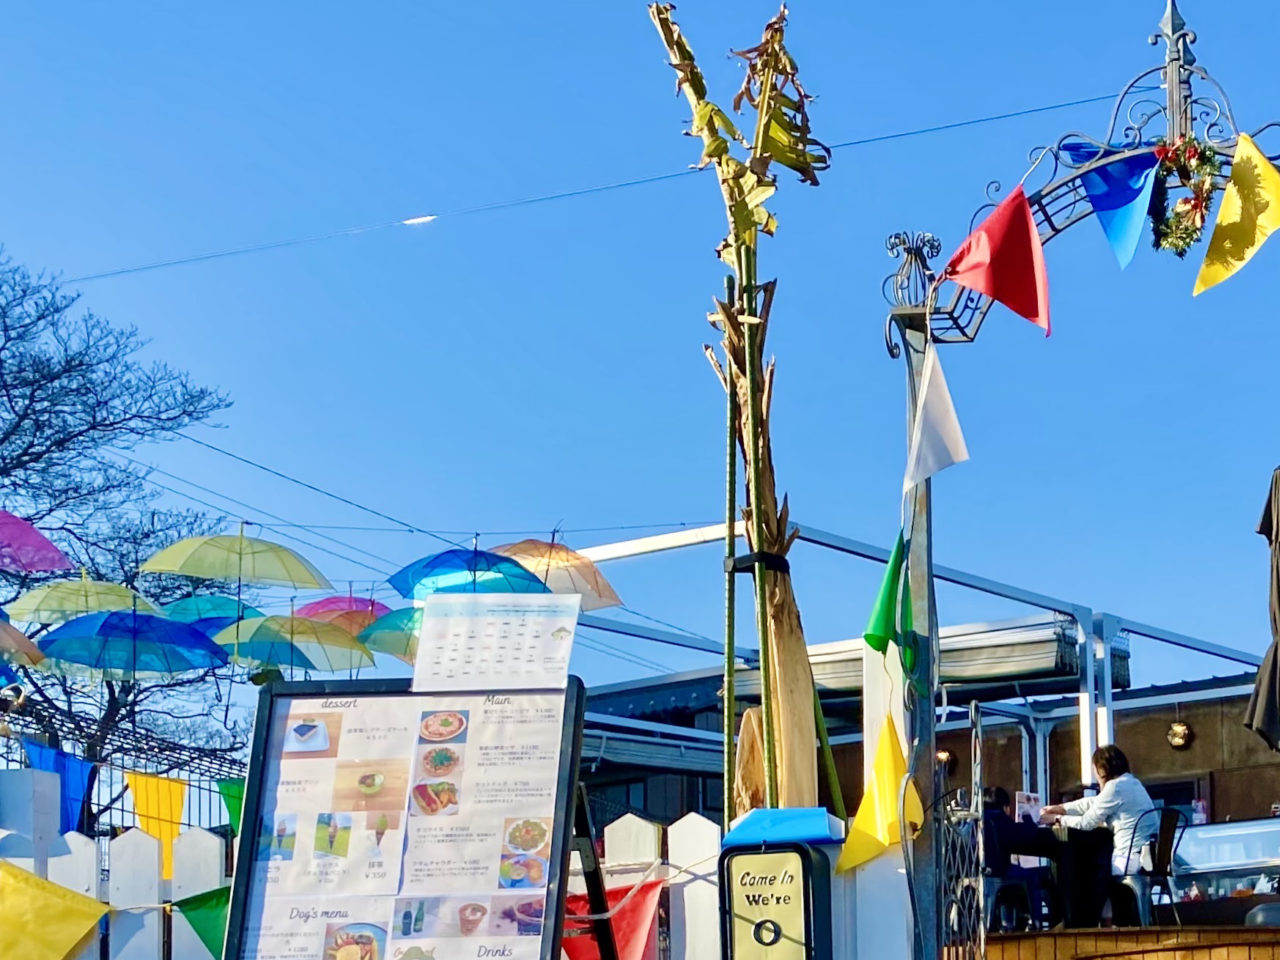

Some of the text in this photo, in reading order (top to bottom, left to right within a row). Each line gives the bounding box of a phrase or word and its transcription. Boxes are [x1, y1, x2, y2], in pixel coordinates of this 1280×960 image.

[321, 699, 358, 708] dessert
[483, 695, 512, 705] Main
[739, 870, 794, 886] Come In
[745, 893, 791, 906] We're
[289, 907, 349, 923] Dog's menu
[477, 945, 513, 957] Drinks
